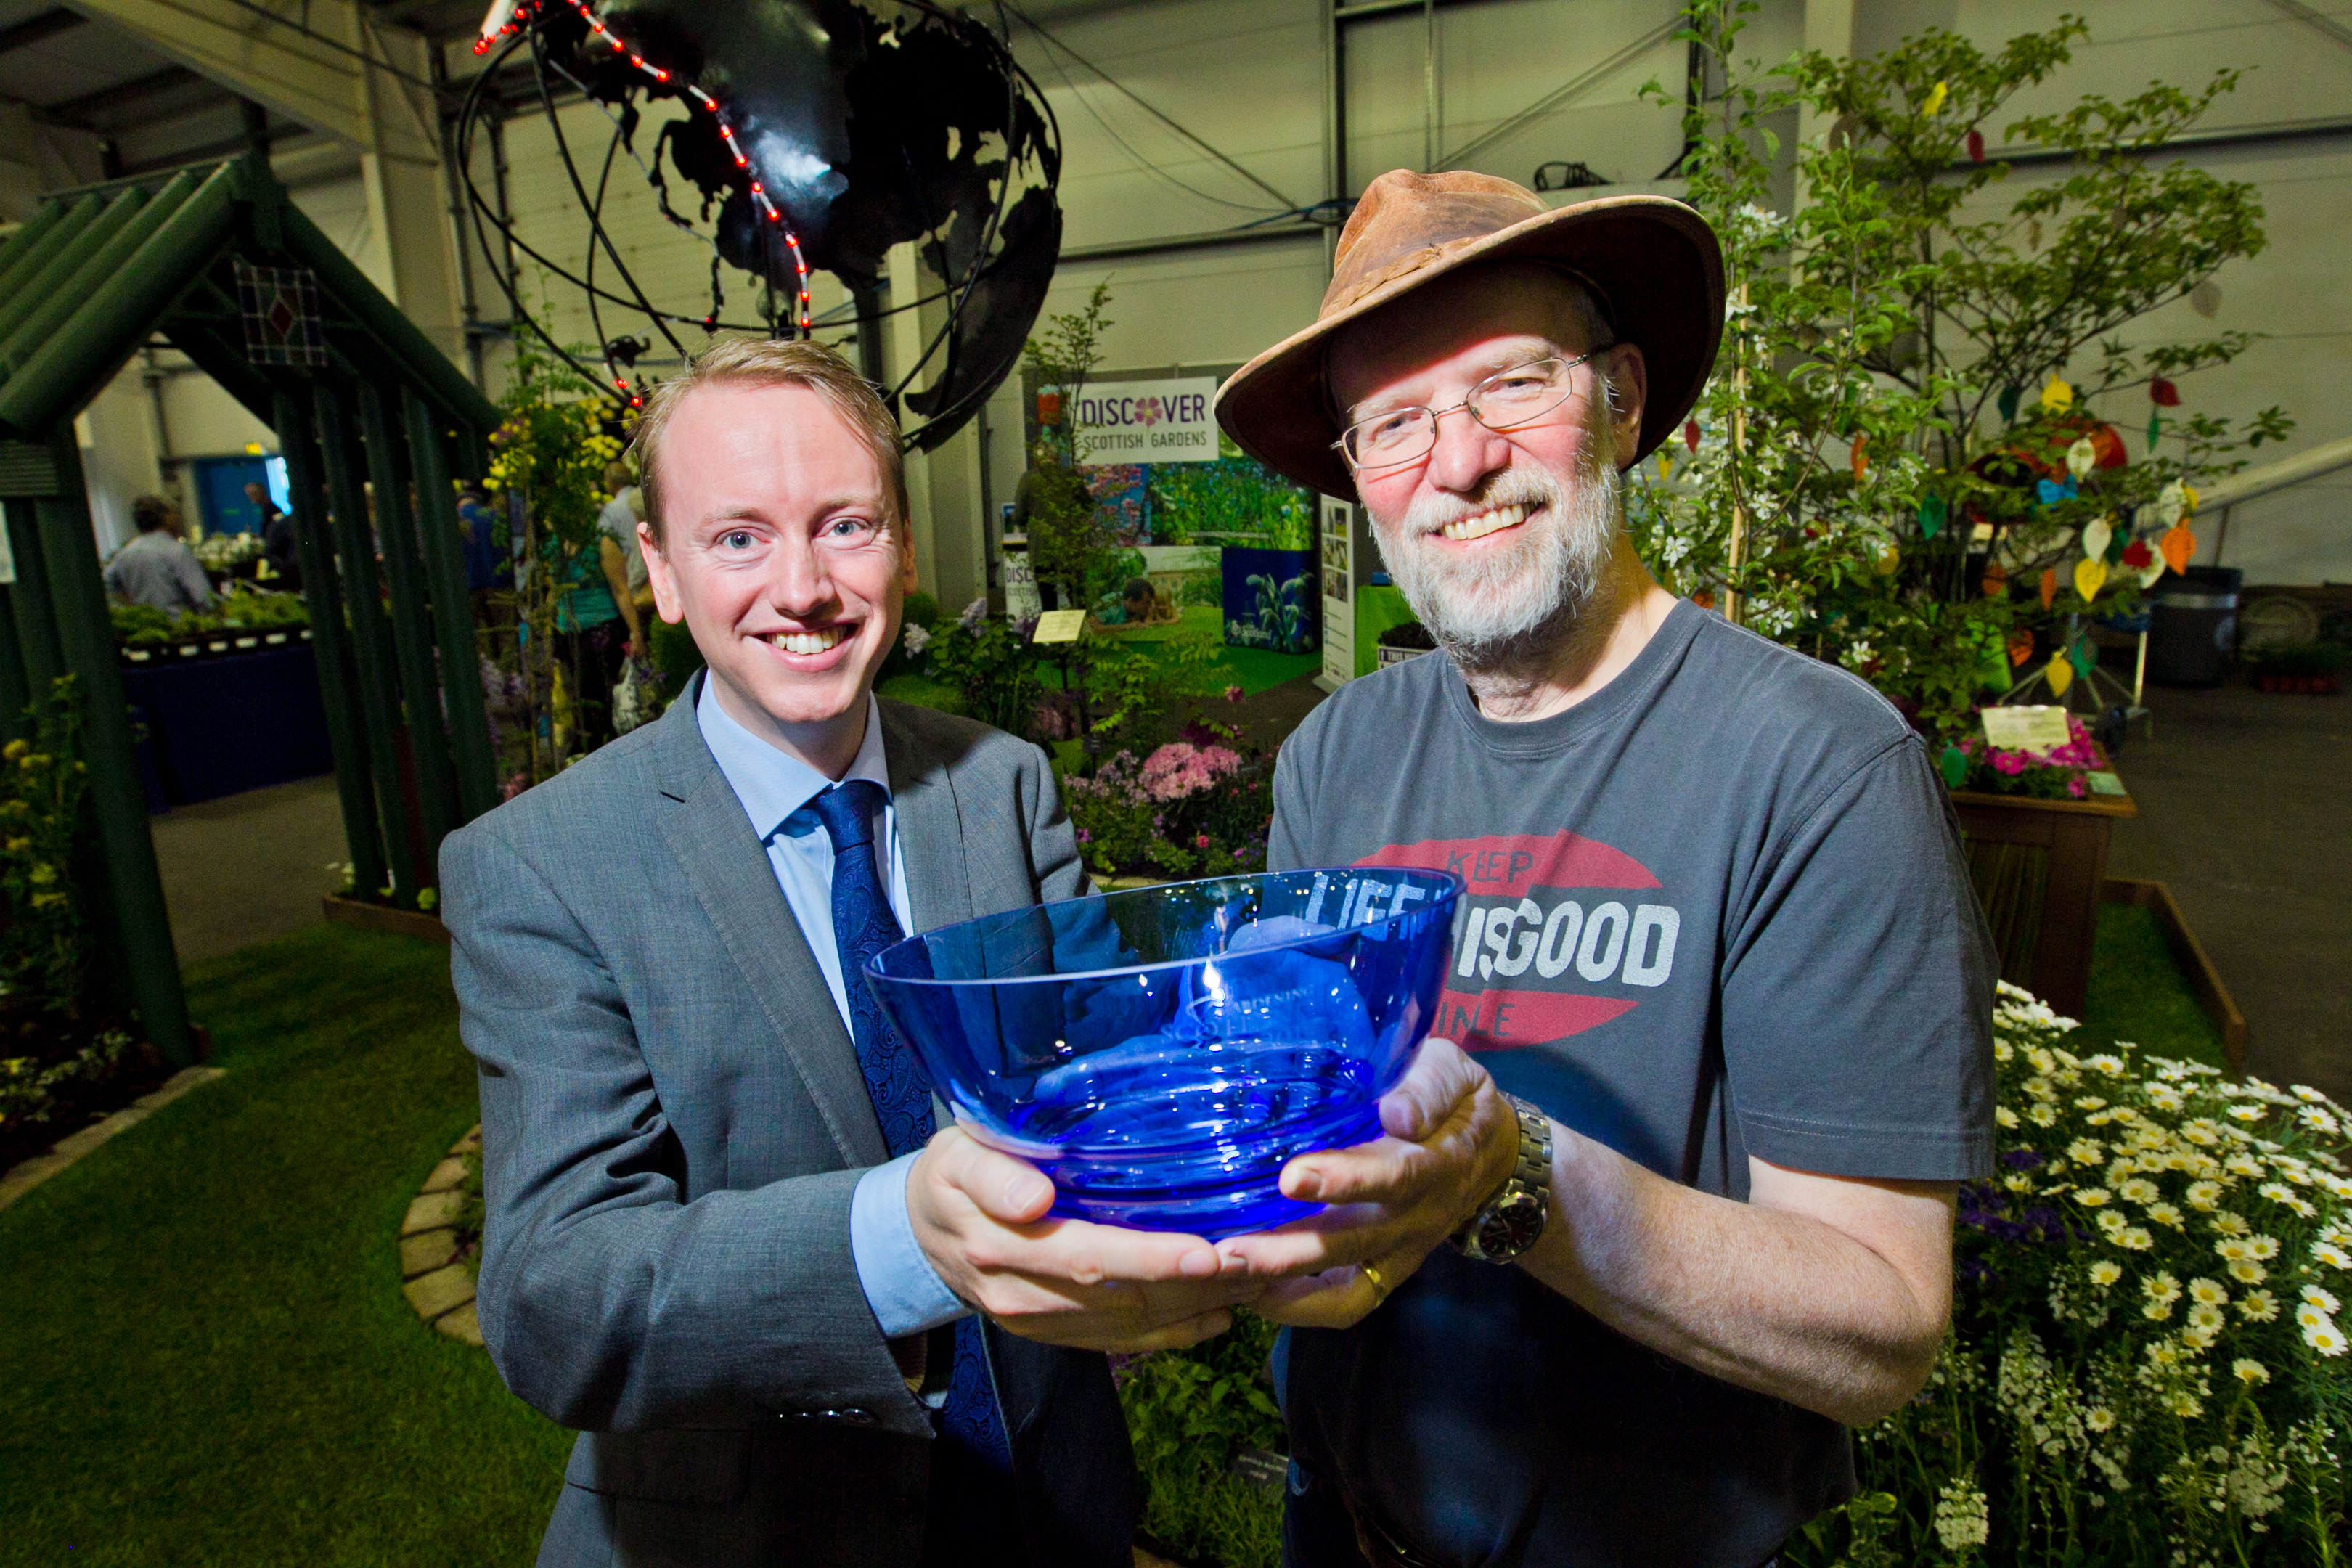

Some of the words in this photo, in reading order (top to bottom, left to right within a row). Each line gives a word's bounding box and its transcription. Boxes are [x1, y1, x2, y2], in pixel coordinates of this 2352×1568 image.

[1084, 433, 1143, 450] SCOTTISH
[1151, 431, 1206, 447] GARDENS
[1006, 566, 1034, 583] DISC
[1445, 850, 1534, 883] KEEP
[1493, 898, 1681, 987] GOOD
